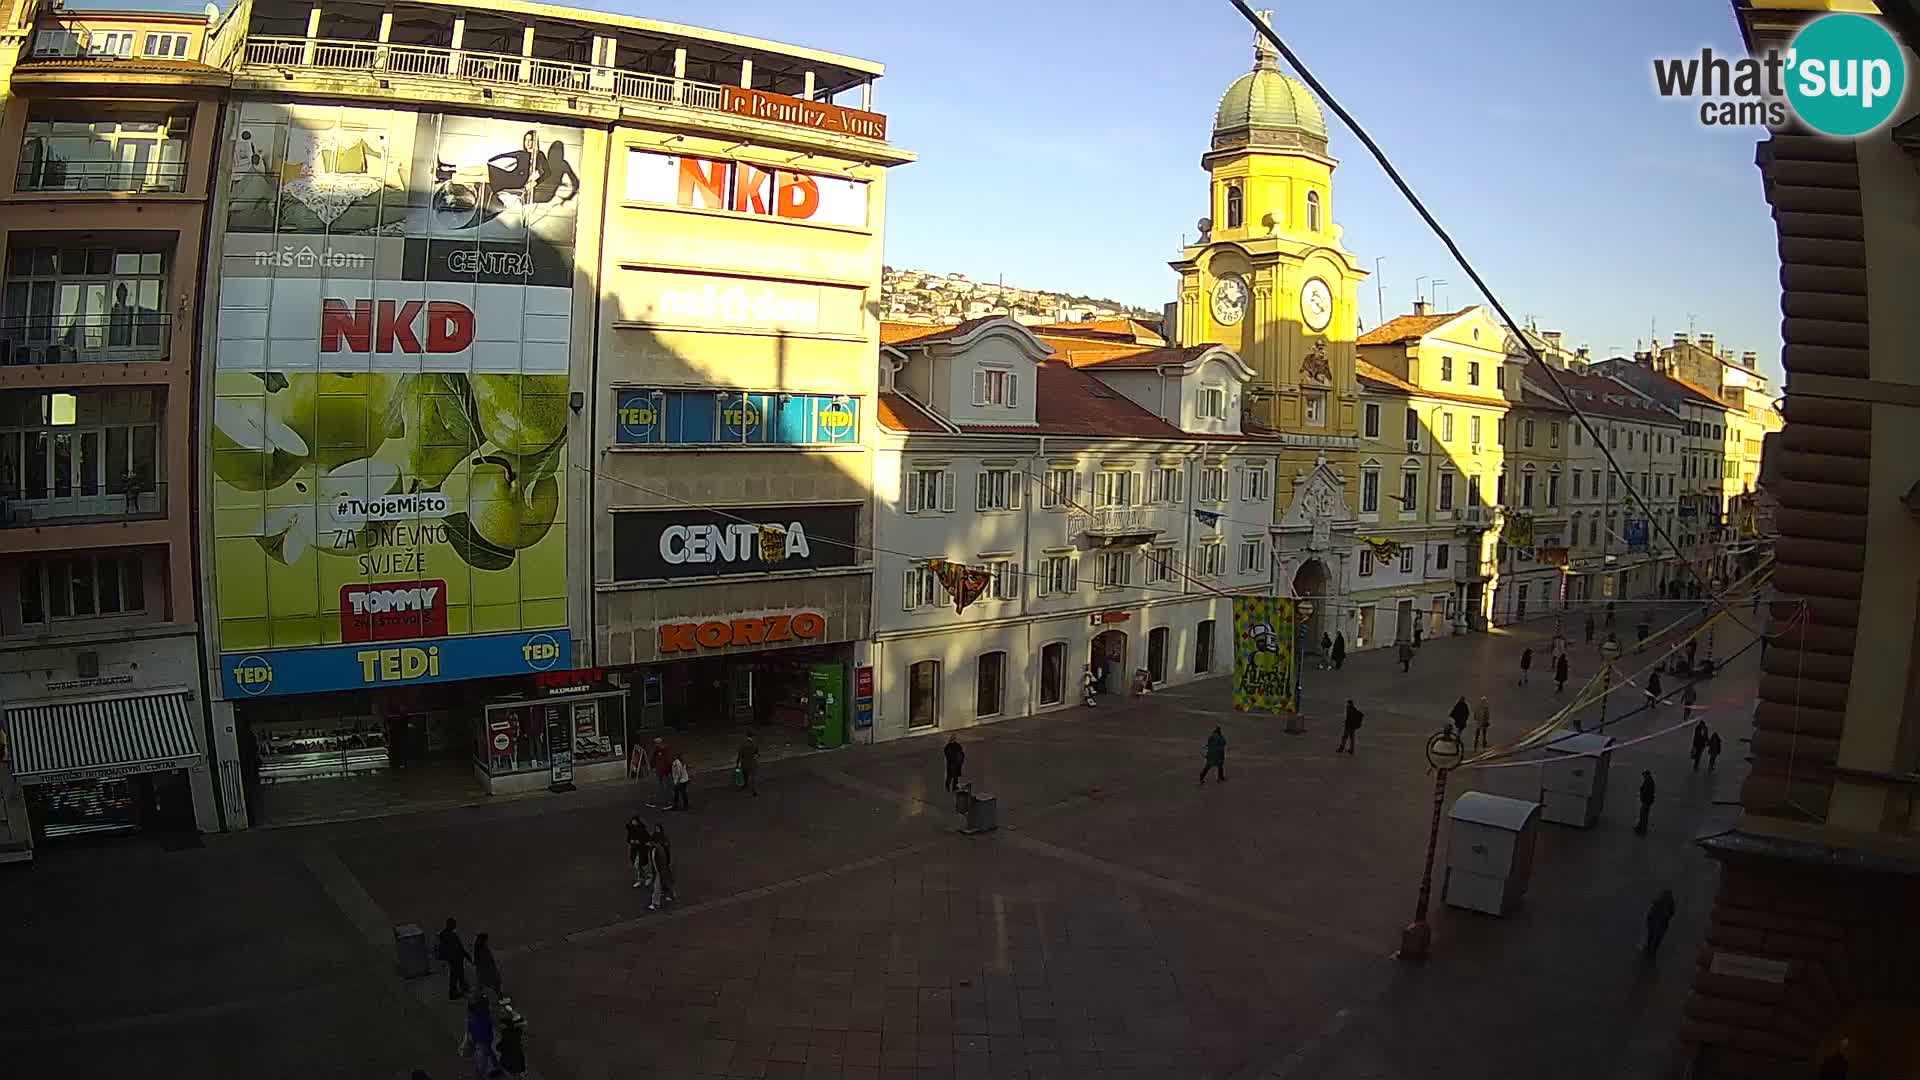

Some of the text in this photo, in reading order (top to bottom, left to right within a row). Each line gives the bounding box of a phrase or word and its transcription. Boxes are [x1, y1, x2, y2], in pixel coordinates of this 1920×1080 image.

[722, 88, 885, 138] Le Rendez-Vous
[677, 156, 819, 220] NKD
[255, 246, 367, 269] naš dom
[448, 250, 534, 276] CENTRA
[320, 297, 477, 354] NKD
[618, 407, 657, 426] TEDi
[723, 410, 760, 426] TEDi
[337, 497, 446, 518] #TvojeMisto
[333, 524, 449, 550] ZA DNEVNO
[359, 549, 426, 576] SVJEŽE
[348, 586, 439, 615] TOMMY
[659, 612, 826, 654] KORZO
[357, 646, 440, 683] TEDi
[523, 642, 560, 662] TEDi
[233, 667, 272, 687] TEDi
